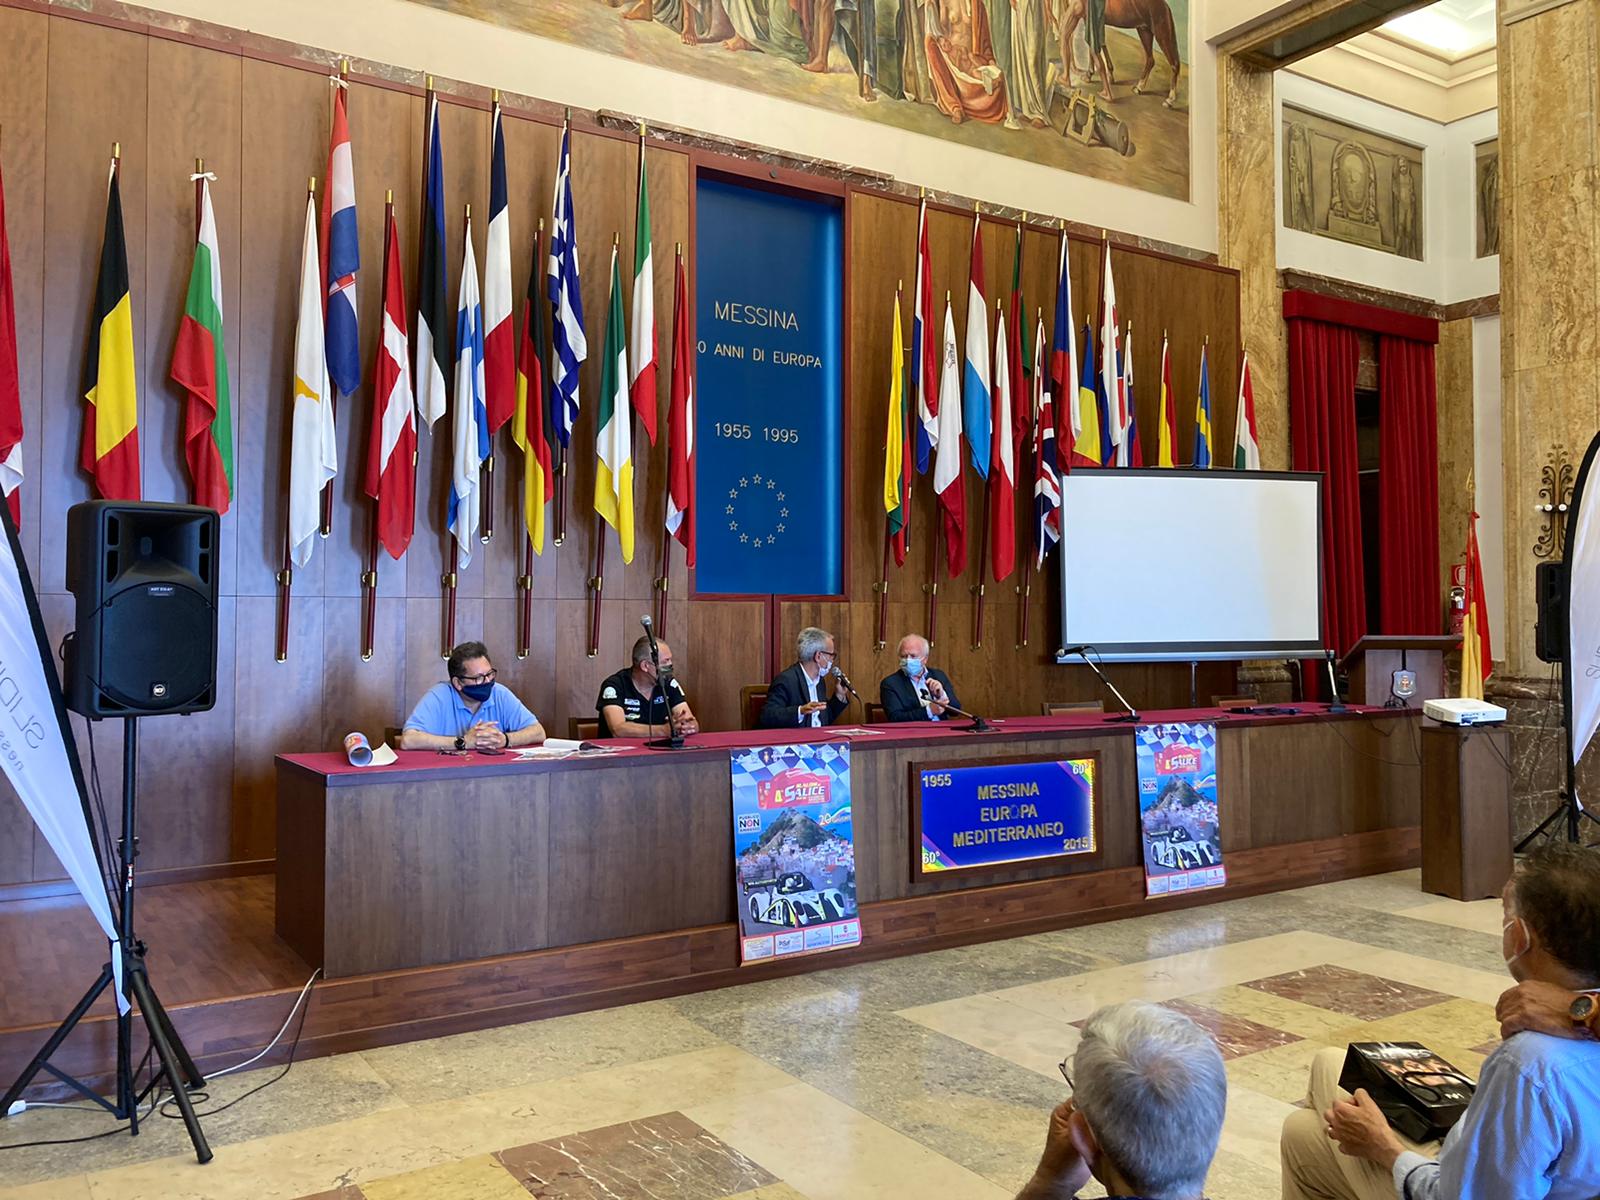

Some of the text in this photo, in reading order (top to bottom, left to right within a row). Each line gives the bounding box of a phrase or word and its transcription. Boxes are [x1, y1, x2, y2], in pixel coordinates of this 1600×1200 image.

[714, 301, 799, 332] MESSINA
[696, 340, 822, 369] 0 ANNI DI EUROPA
[714, 422, 799, 444] 1955 1995
[922, 773, 952, 788] 1955
[783, 785, 825, 804] SALICE
[977, 781, 1040, 800] MESSINA
[980, 803, 1038, 822] EUROPA
[739, 818, 760, 828] NON
[952, 821, 1064, 848] MEDITERRANEO
[1063, 837, 1089, 851] 2015
